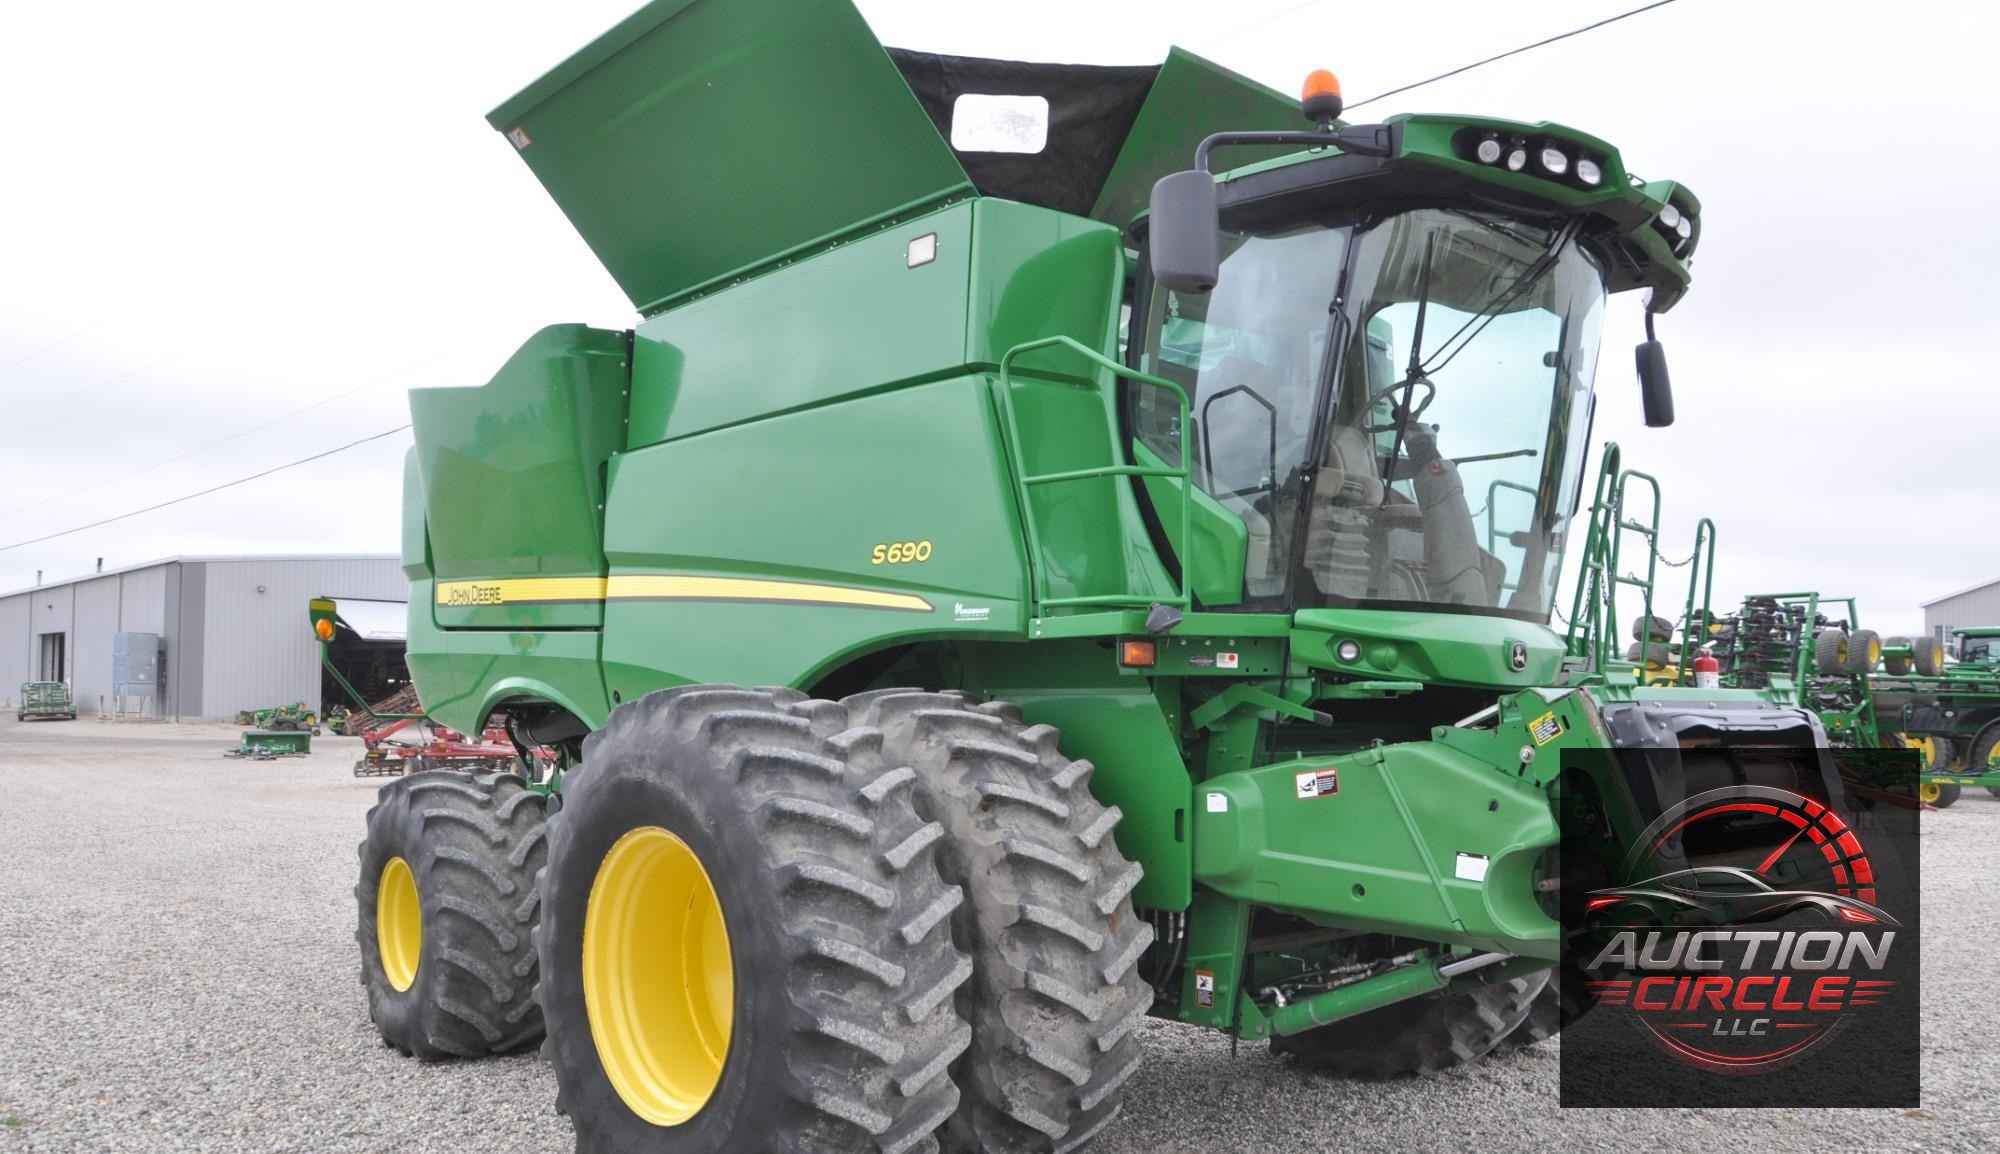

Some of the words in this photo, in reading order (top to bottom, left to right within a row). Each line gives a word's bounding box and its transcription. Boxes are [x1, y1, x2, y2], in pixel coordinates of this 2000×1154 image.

[871, 540, 932, 565] S690
[447, 587, 470, 603] JOHN
[471, 585, 501, 602] DEERE
